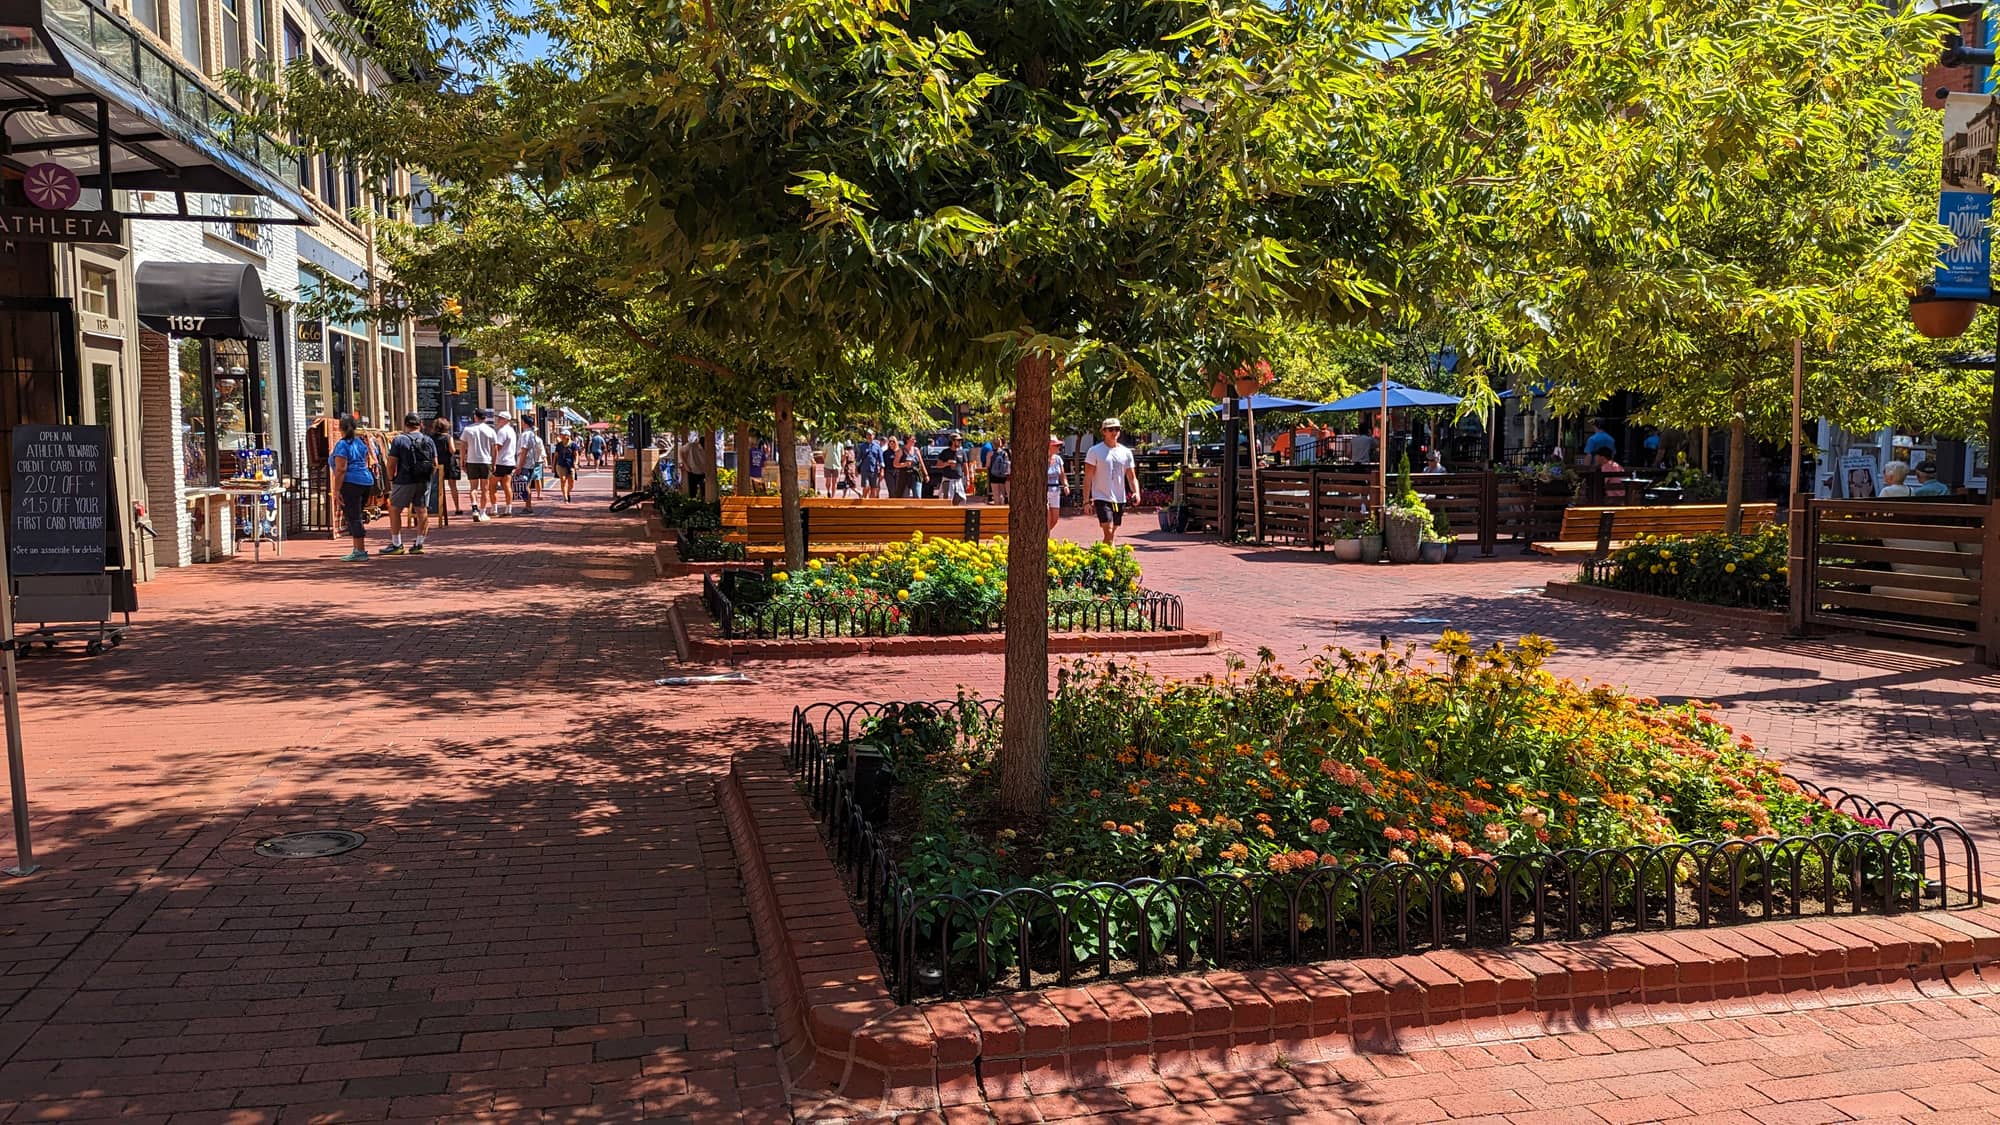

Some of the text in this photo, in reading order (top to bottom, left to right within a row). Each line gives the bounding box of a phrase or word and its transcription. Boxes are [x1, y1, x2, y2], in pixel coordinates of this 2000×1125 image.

[1949, 211, 1985, 238] DOWN
[167, 315, 205, 331] 1137
[298, 323, 321, 341] lolo
[40, 431, 72, 441] OPEN AN
[26, 444, 99, 458] ATHLETA REWARDS
[17, 460, 97, 473] CREDIT CARD FOR
[24, 474, 56, 494] 20%
[62, 474, 87, 495] OFF
[22, 496, 99, 514] $15 OFF YOUR
[17, 516, 104, 530] FIRST CARD PURCHASE
[40, 545, 70, 554] associate
